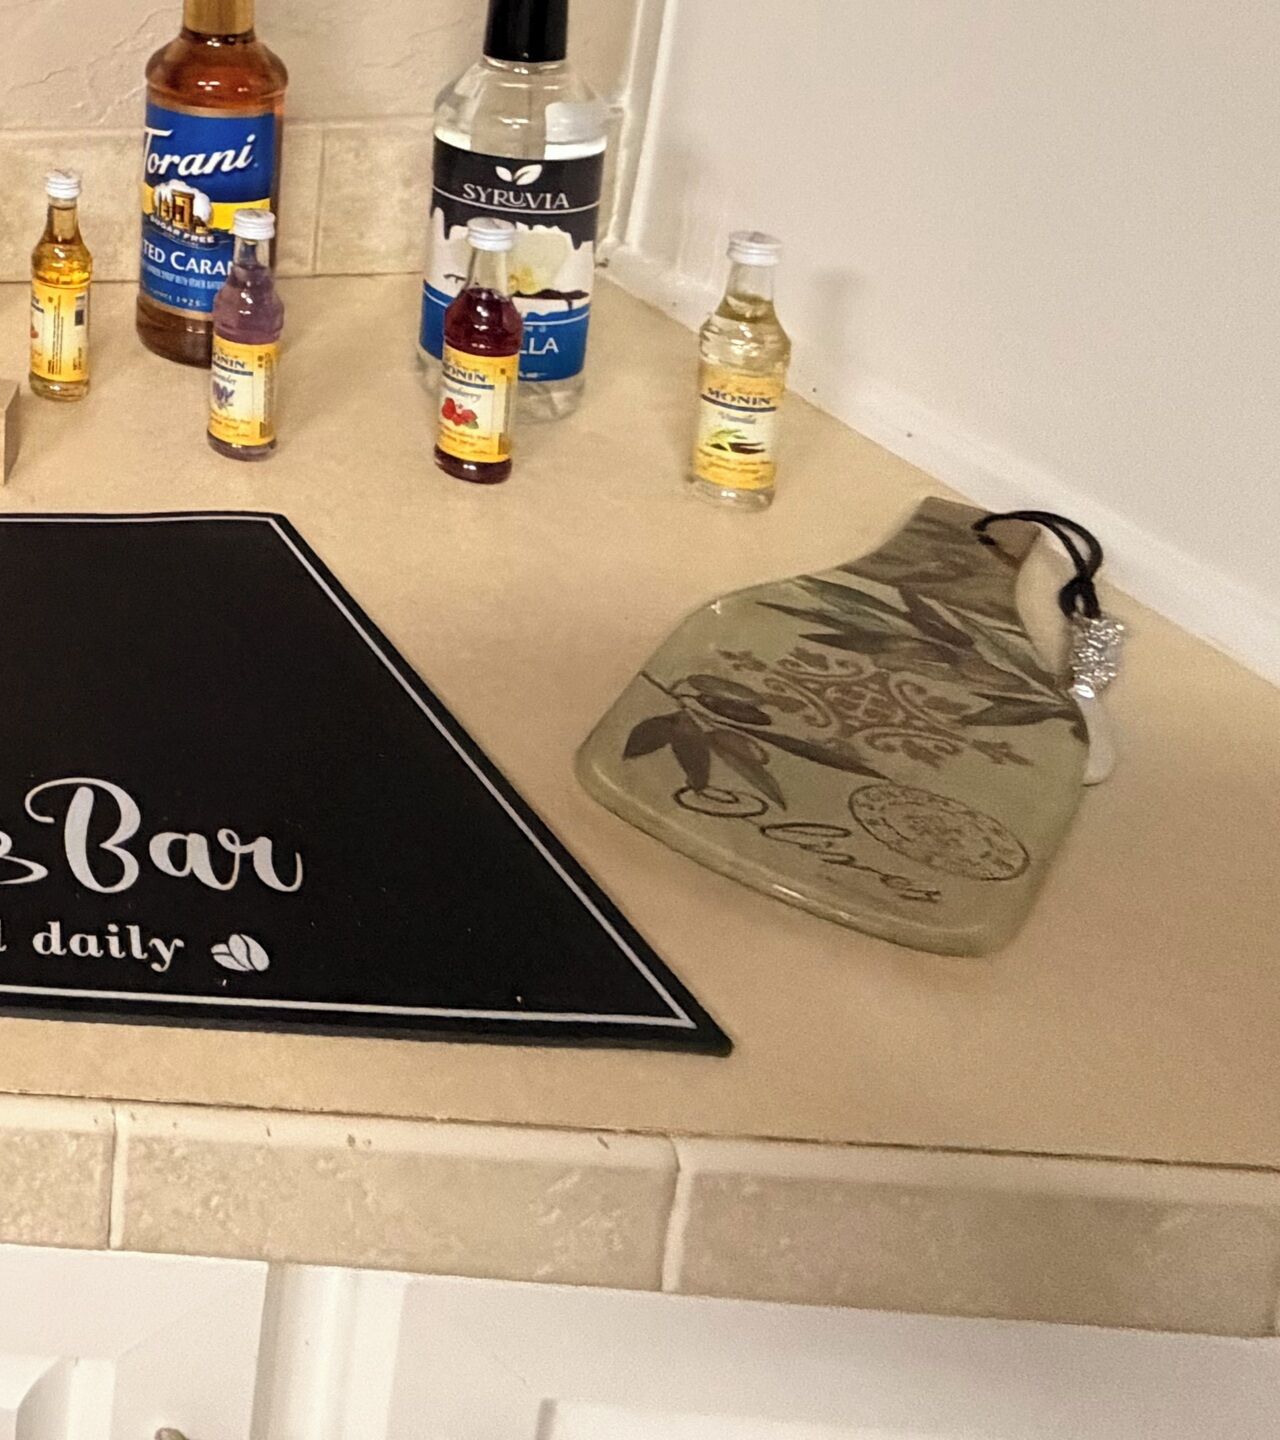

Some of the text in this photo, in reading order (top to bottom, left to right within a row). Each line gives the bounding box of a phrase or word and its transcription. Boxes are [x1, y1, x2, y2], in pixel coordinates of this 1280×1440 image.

[143, 125, 257, 177] Torani
[462, 183, 570, 209] SYRUVIA
[183, 232, 215, 244] FREE
[143, 239, 166, 264] TED
[213, 353, 246, 369] ONIN
[24, 776, 304, 894] Bar
[33, 919, 186, 973] daily
